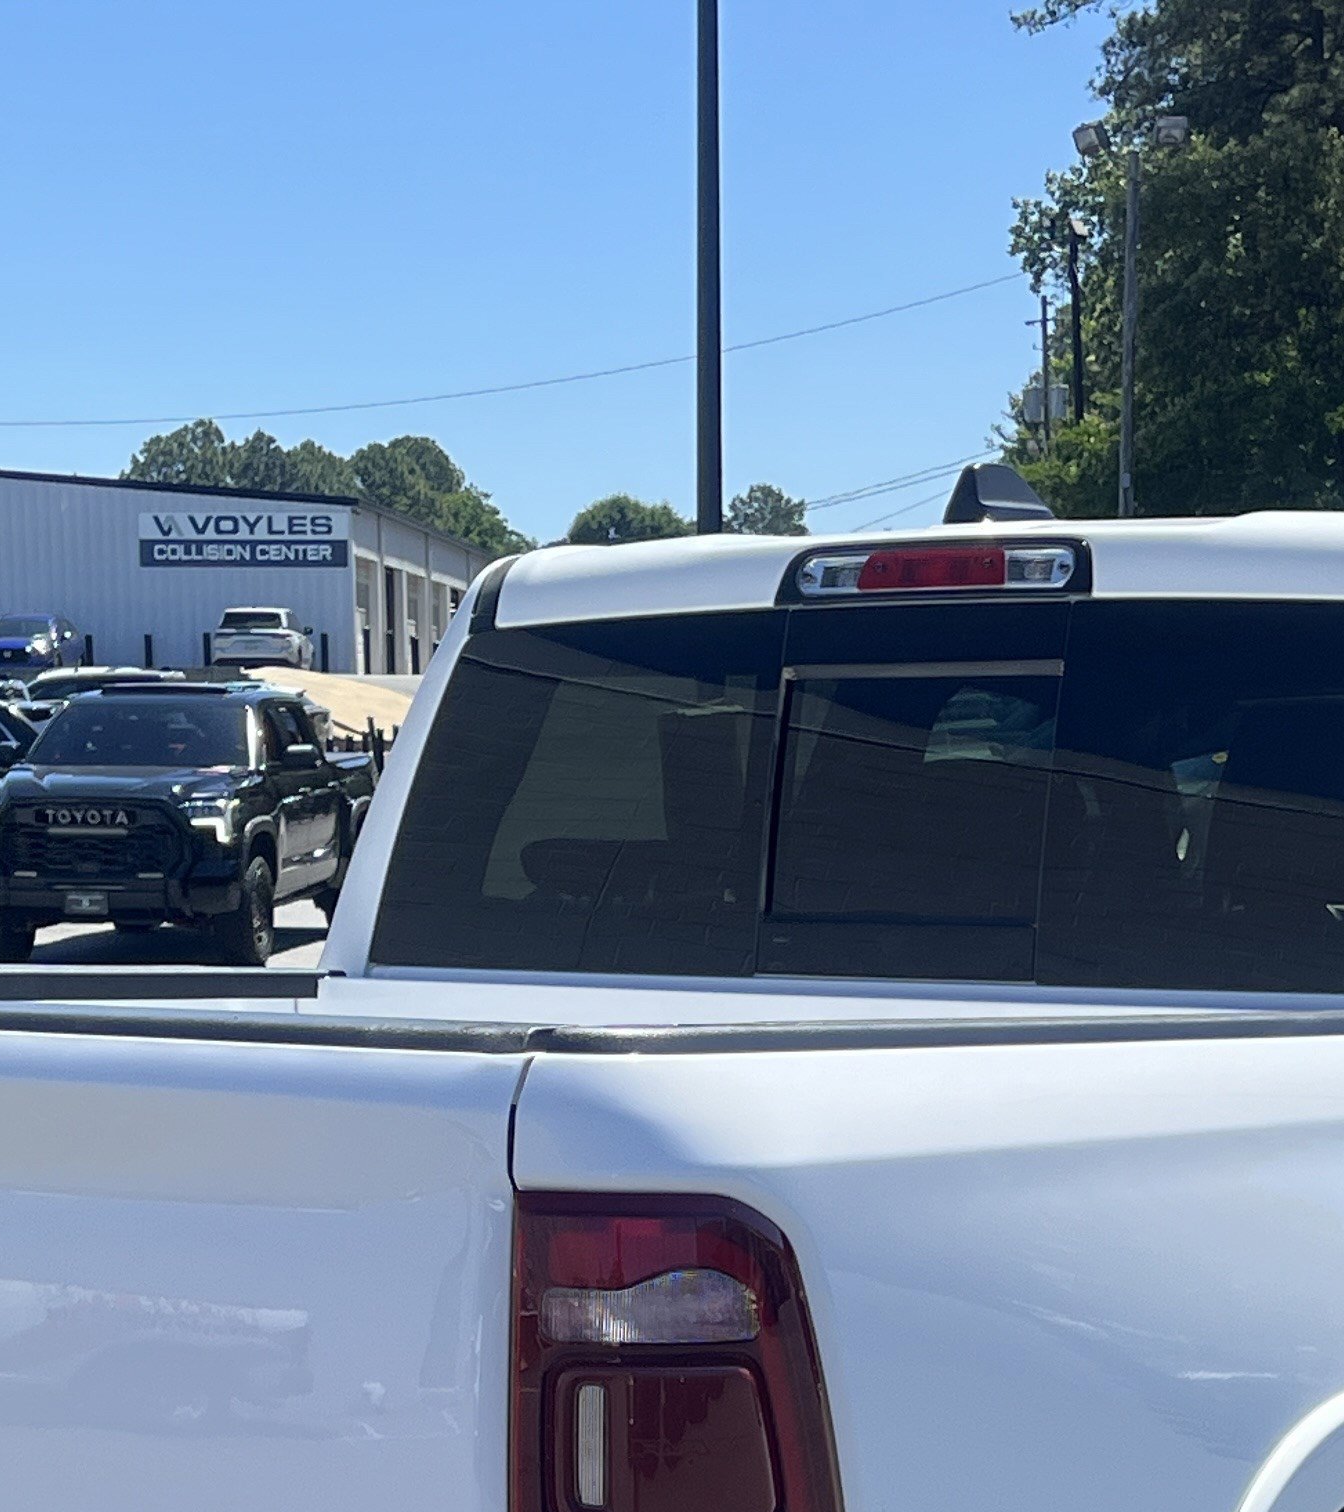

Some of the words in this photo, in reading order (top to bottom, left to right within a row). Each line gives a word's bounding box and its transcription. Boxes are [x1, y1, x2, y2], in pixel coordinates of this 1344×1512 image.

[188, 514, 333, 536] VOYLES
[153, 543, 250, 562] COLLISION
[256, 543, 333, 562] CENTER
[45, 808, 129, 825] TOYOTA
